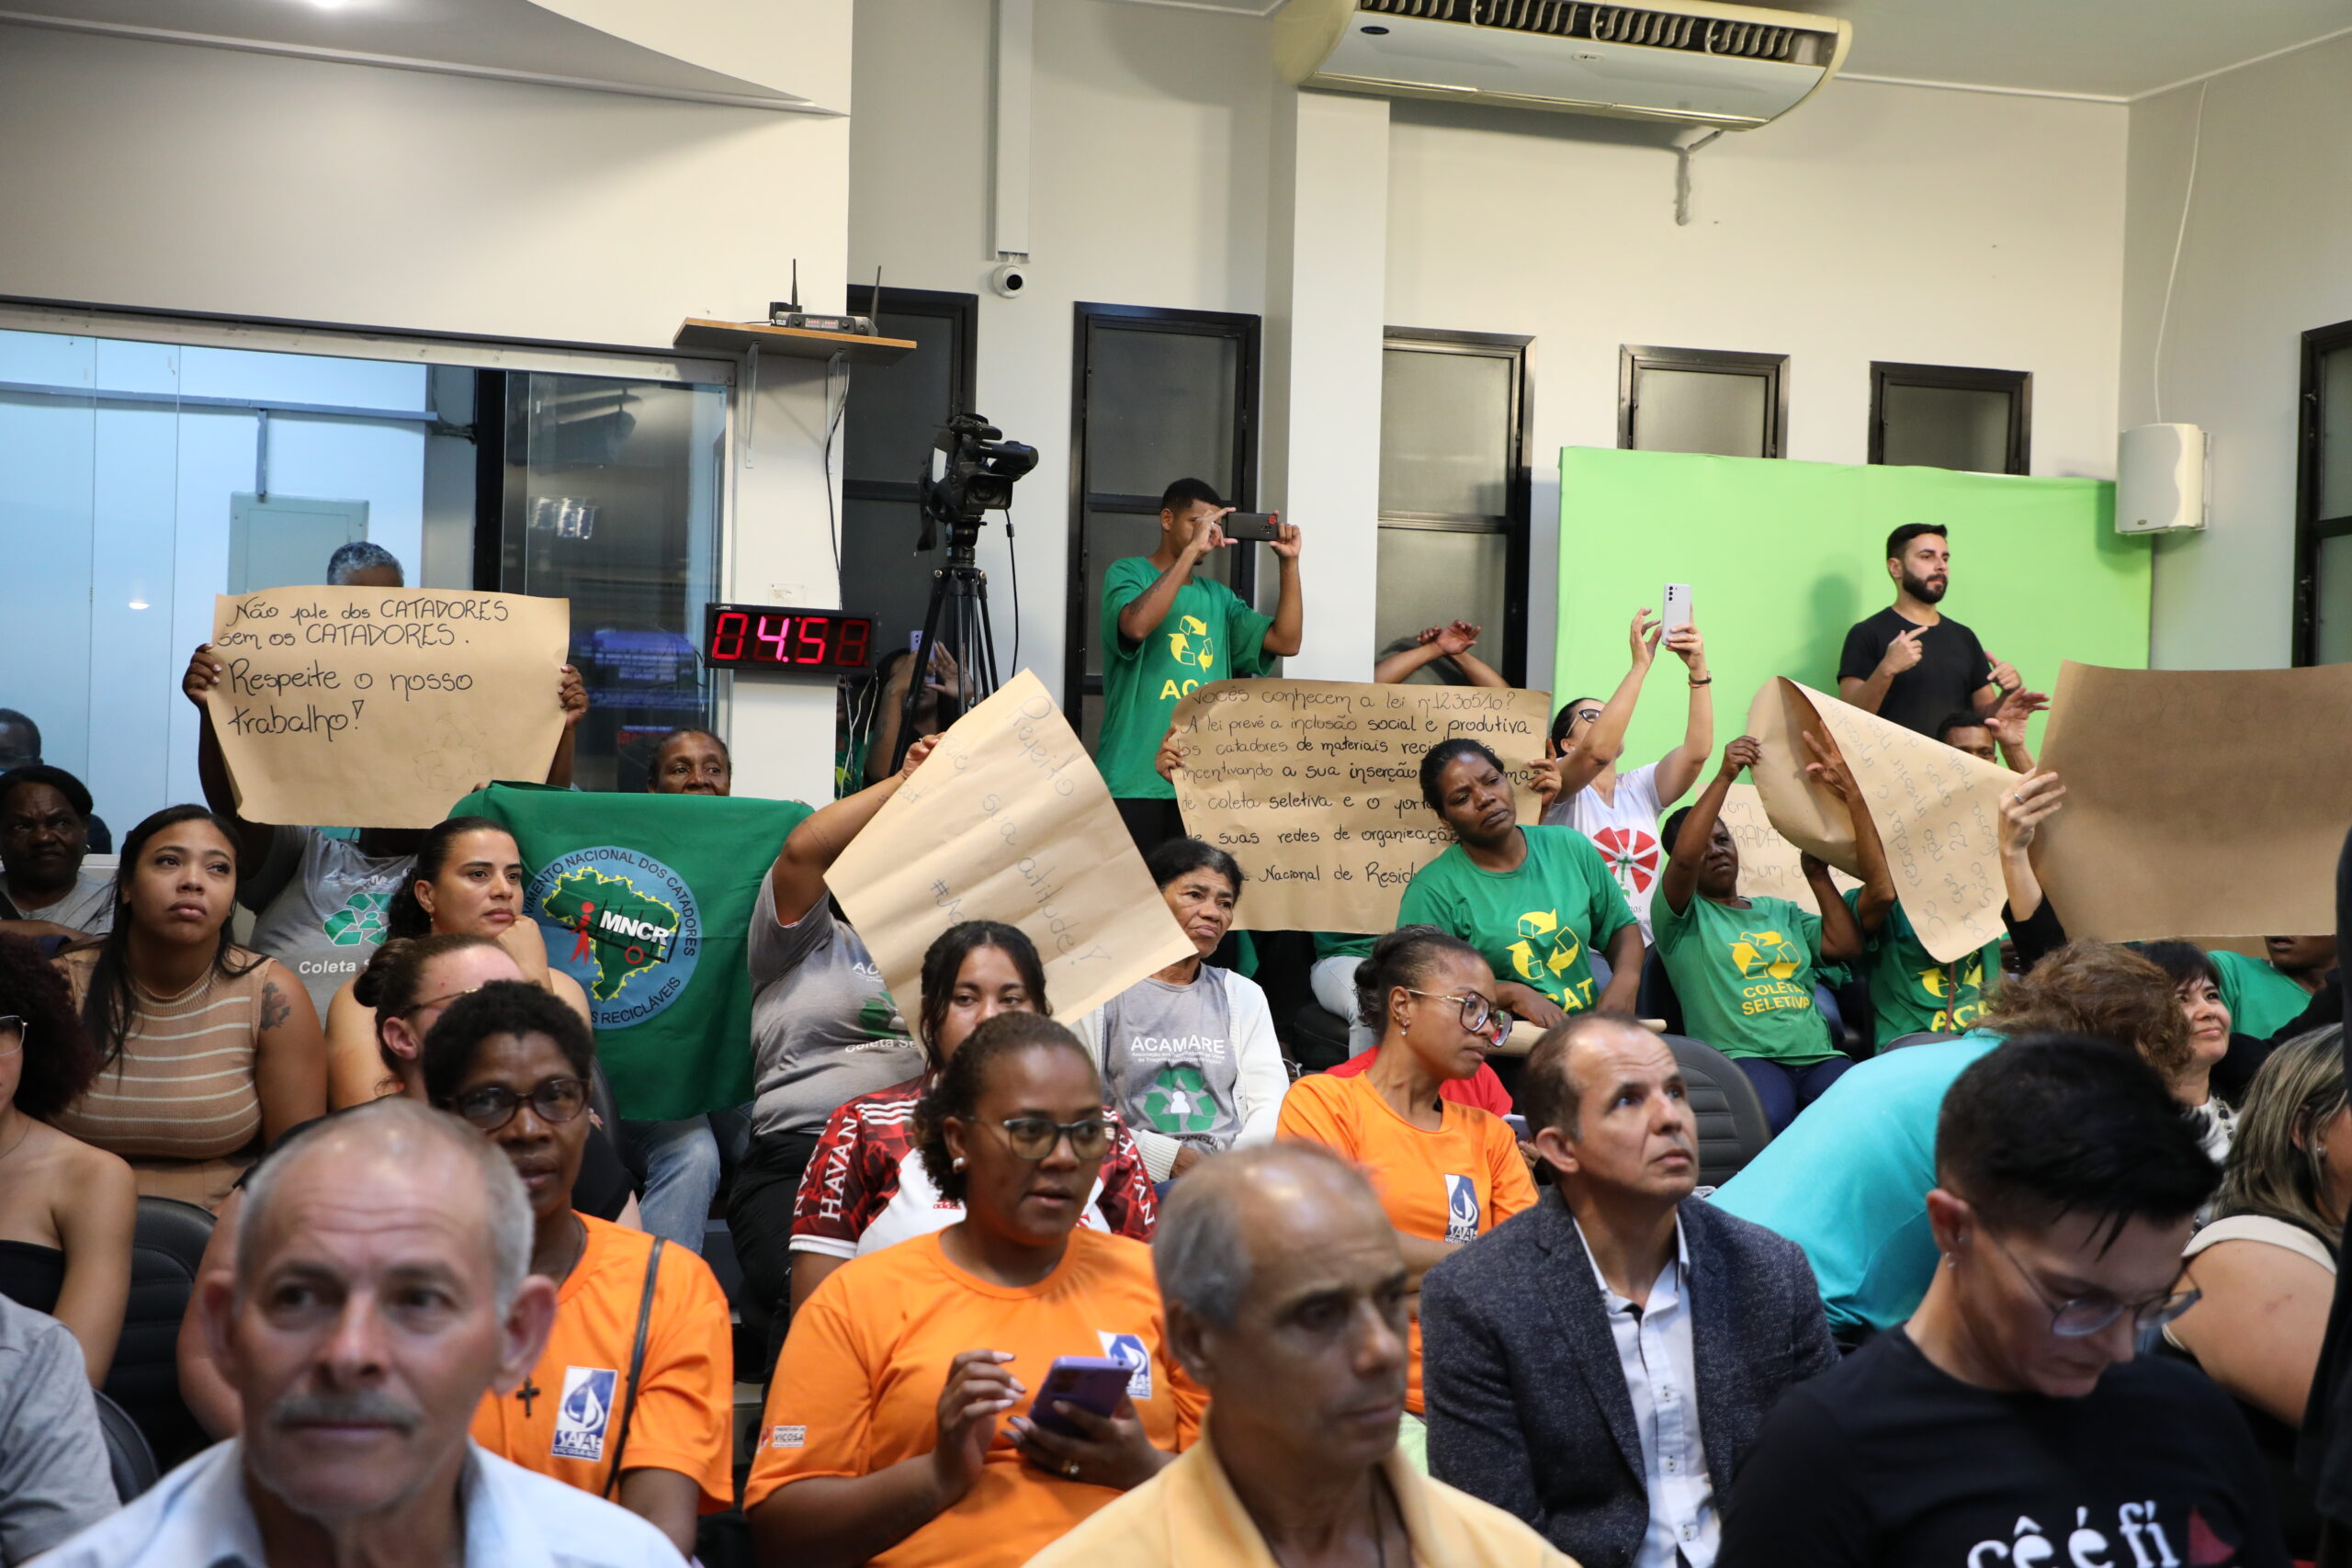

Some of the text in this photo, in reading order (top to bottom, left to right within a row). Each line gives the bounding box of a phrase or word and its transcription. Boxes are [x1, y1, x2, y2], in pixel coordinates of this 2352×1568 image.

[226, 596, 279, 626] Não
[340, 602, 372, 620] dos
[379, 598, 510, 622] CATADORES
[218, 630, 263, 649] sem
[268, 631, 297, 647] os
[228, 657, 474, 701] Respeite o nosso
[1261, 688, 1351, 713] conhecem
[1360, 693, 1375, 708] a
[1385, 692, 1407, 709] lei
[1181, 715, 1198, 734] A
[1207, 715, 1224, 732] lei
[1270, 720, 1283, 729] a
[1291, 716, 1358, 735] inclusão
[1367, 716, 1418, 732] social
[1425, 718, 1439, 733] e
[1446, 716, 1532, 740] produtiva
[1216, 738, 1288, 756] catadores
[1296, 736, 1314, 751] de
[1321, 738, 1389, 757] materiais
[1282, 765, 1297, 777] a
[1305, 765, 1340, 779] sua
[1349, 761, 1418, 784] inserção
[1182, 792, 1197, 812] de
[1208, 790, 1261, 810] coleta
[1269, 792, 1333, 809] seletiva
[1342, 795, 1355, 807] e
[1366, 797, 1380, 809] o
[1218, 832, 1261, 844] suas
[1277, 828, 1320, 844] redes
[1333, 824, 1351, 840] de
[1258, 864, 1320, 883] Nacional
[1334, 864, 1353, 881] de
[565, 849, 636, 869] NACIONAL
[638, 857, 668, 879] DOS
[666, 877, 698, 957] CATADORES
[599, 909, 671, 946] MNCR
[299, 960, 356, 975] Coleta
[601, 976, 682, 1025] RECICLÁVEIS
[1742, 982, 1804, 998] COLETA
[1741, 995, 1811, 1016] SELETIVA
[1130, 1034, 1226, 1055] ACAMARE
[819, 1116, 858, 1222] HAVAN
